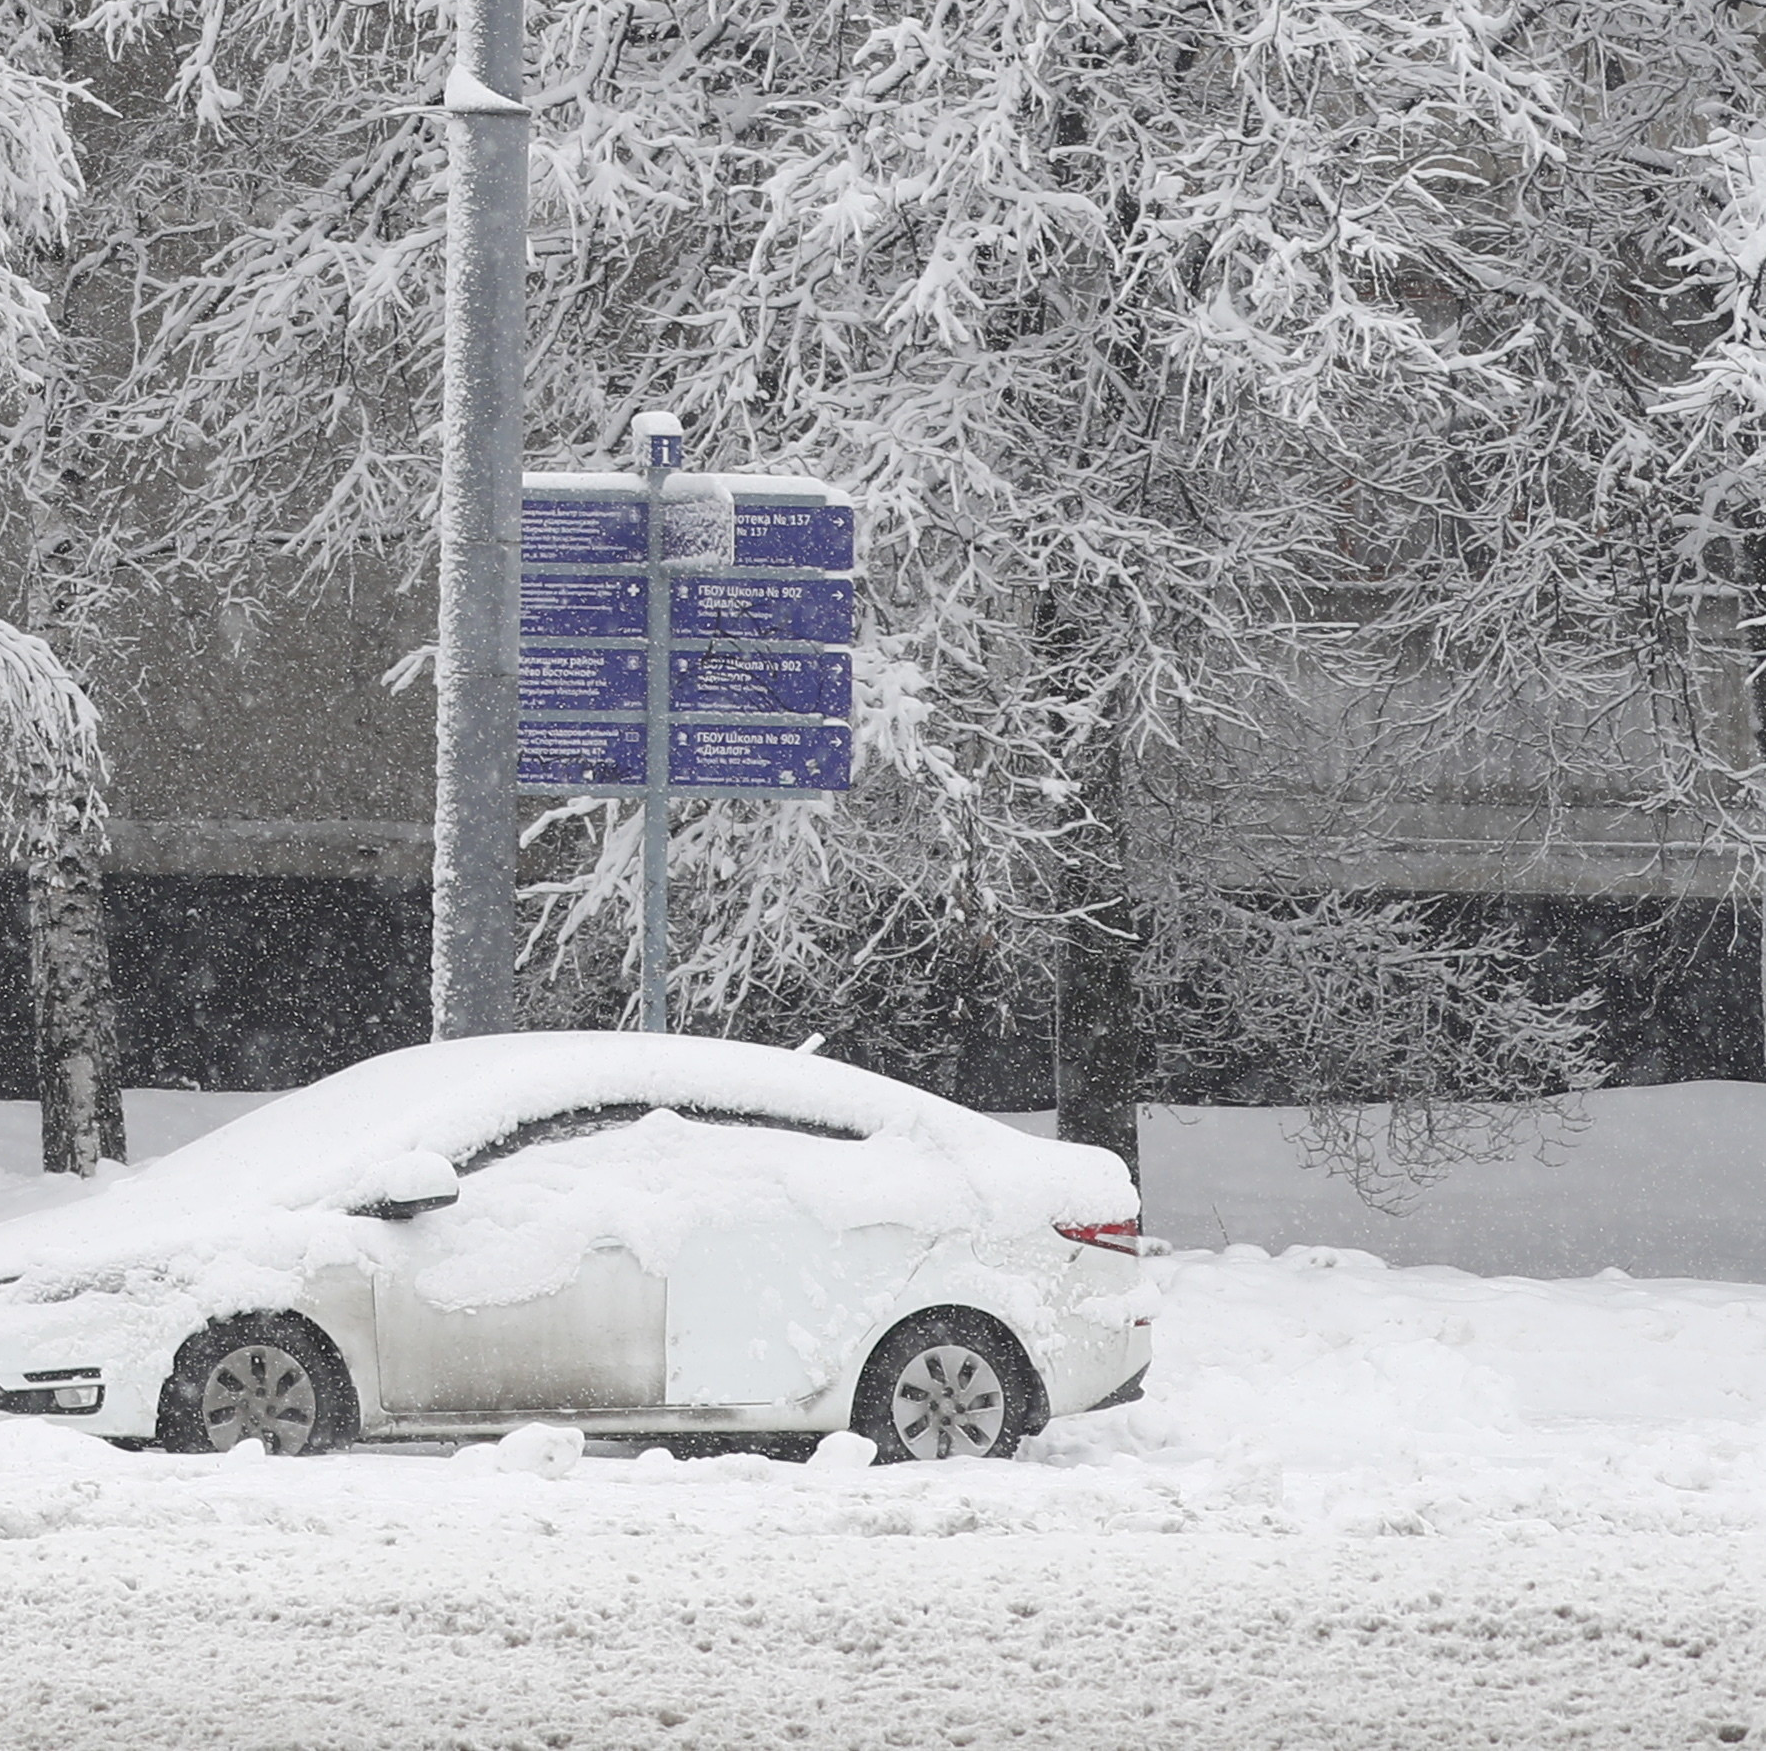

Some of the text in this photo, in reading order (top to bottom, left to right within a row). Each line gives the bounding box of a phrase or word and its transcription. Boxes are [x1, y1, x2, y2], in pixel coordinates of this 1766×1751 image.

[790, 514, 811, 525] 137
[750, 527, 768, 536] 137
[698, 585, 725, 596] ГБОУ
[727, 586, 765, 597] Школа
[781, 587, 803, 598] 902
[781, 660, 802, 671] 902
[696, 732, 725, 743] ГБОУ
[726, 731, 763, 744] Школа
[780, 734, 801, 745] 902
[696, 744, 751, 756] «Диалог»
